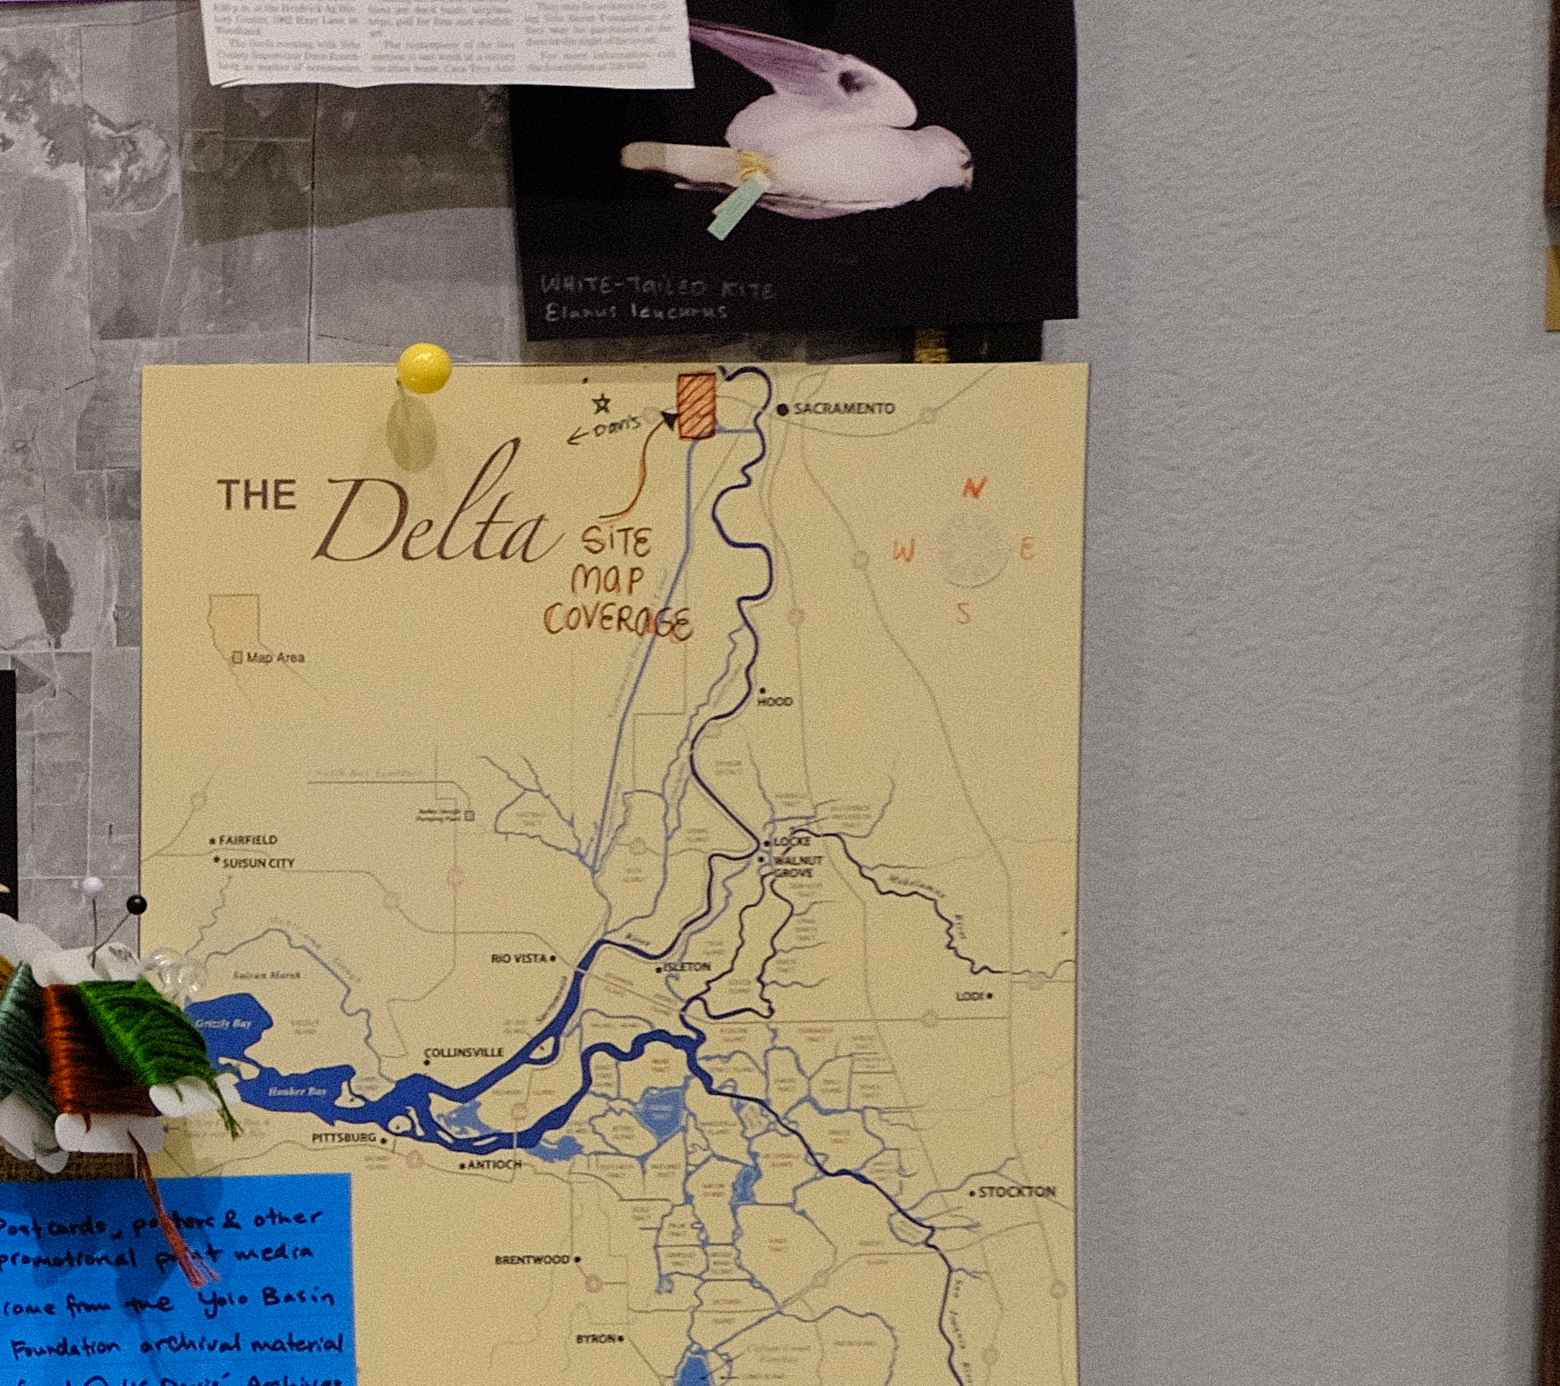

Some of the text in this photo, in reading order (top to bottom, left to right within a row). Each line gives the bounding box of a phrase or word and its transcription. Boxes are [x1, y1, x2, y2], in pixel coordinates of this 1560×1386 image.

[794, 402, 896, 415] SACRAMENTO
[217, 436, 564, 563] THE Delta
[219, 835, 277, 845] FAIRFIELD
[425, 1047, 504, 1058] COLLINSVILLE
[312, 1133, 377, 1144] PITTSBURG
[468, 1159, 522, 1170] ANTIOCH
[978, 1186, 1055, 1199] STOCKTON
[495, 1254, 570, 1265] BRENTWOOD
